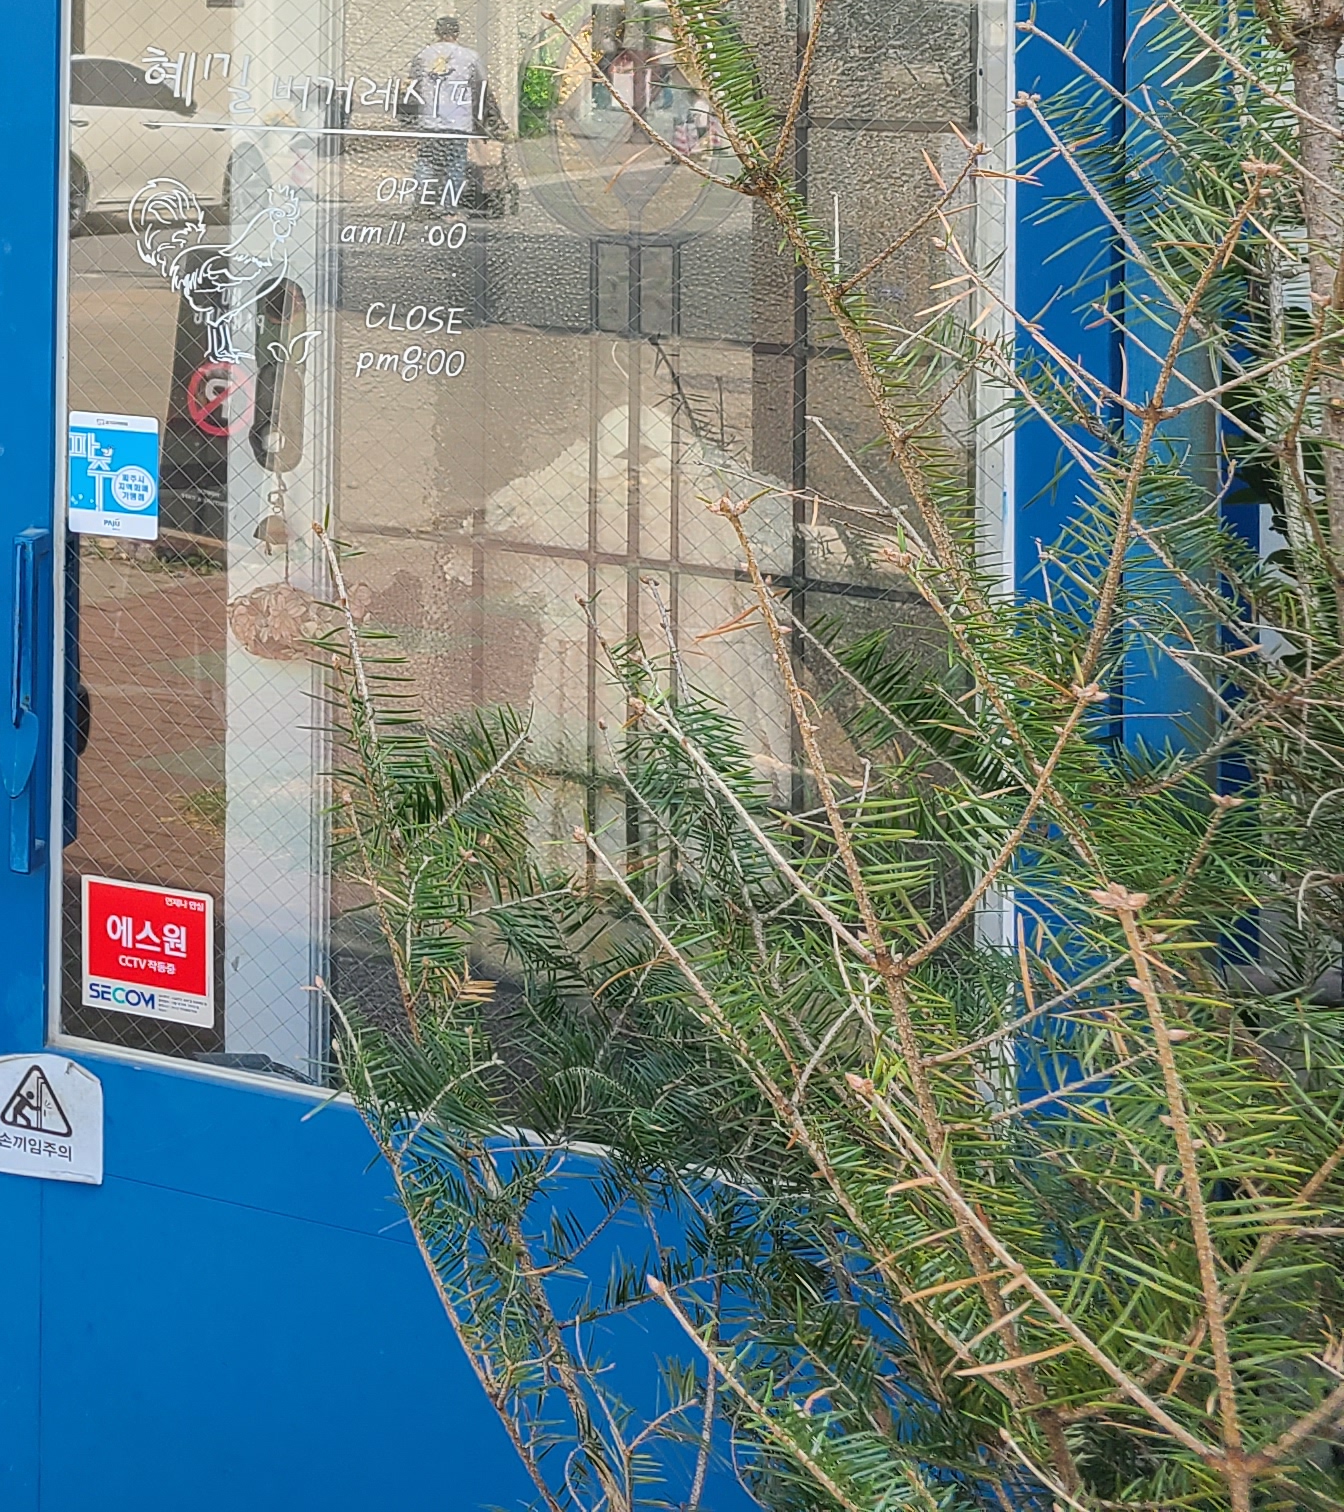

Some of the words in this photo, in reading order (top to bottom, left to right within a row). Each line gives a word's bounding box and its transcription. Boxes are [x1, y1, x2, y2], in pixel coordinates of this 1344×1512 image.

[273, 75, 488, 120] 버거레시피
[376, 177, 466, 207] OPEN
[365, 302, 465, 334] CLOSE
[122, 473, 145, 484] 파주시
[103, 518, 121, 527] PAJU
[106, 915, 187, 959] 에스원
[118, 955, 147, 970] CCTV
[147, 959, 177, 976] 작동중
[89, 982, 155, 1010] SECOM
